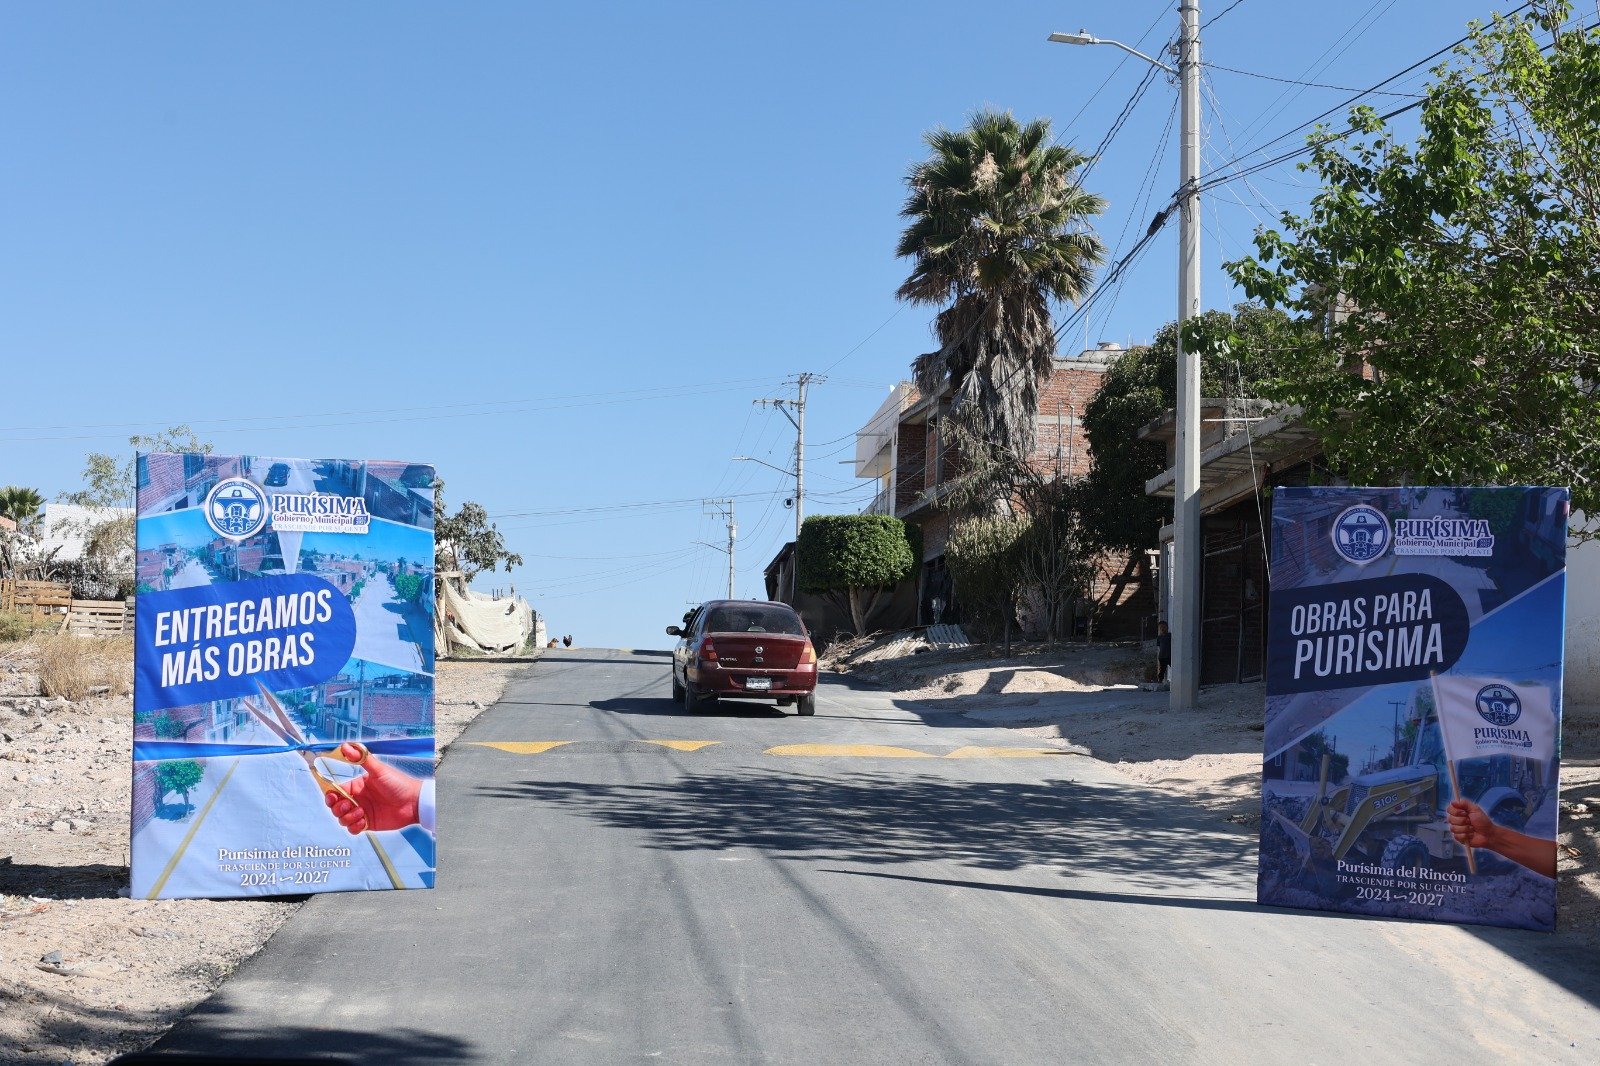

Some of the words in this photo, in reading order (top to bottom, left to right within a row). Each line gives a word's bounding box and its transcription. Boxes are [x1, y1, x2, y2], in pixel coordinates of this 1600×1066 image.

[273, 493, 366, 515] PURÍSIMA
[273, 514, 310, 523] Gobierno
[314, 515, 353, 526] Municipal
[1395, 517, 1491, 540] PURÍSIMA
[1395, 539, 1432, 547] Gobierno
[1436, 539, 1476, 549] Municipal
[155, 589, 332, 647] ENTREGAMOS
[1290, 597, 1366, 636] OBRAS
[1372, 588, 1433, 626] PARA
[161, 643, 221, 688] MÁS
[227, 631, 315, 677] OBRAS
[1293, 622, 1444, 679] PURÍSIMA
[1473, 726, 1531, 742] PURÍSIMA
[218, 848, 279, 861] Purísima
[281, 846, 302, 859] del
[305, 845, 351, 858] Rincón
[218, 862, 280, 872] TRASCIENDE
[283, 862, 302, 870] POR
[305, 861, 317, 869] SU
[319, 859, 351, 868] GENTE
[1337, 859, 1394, 877] Purísima
[1396, 865, 1416, 879] del
[1419, 868, 1466, 883] Rincón
[240, 873, 277, 886] 2024
[294, 870, 330, 884] 2027
[1336, 874, 1394, 888] TRASCIENDE
[1397, 881, 1417, 890] POR
[1419, 882, 1432, 891] SU
[1434, 884, 1467, 894] GENTE
[1356, 886, 1391, 902] 2024
[1408, 891, 1444, 907] 2027
